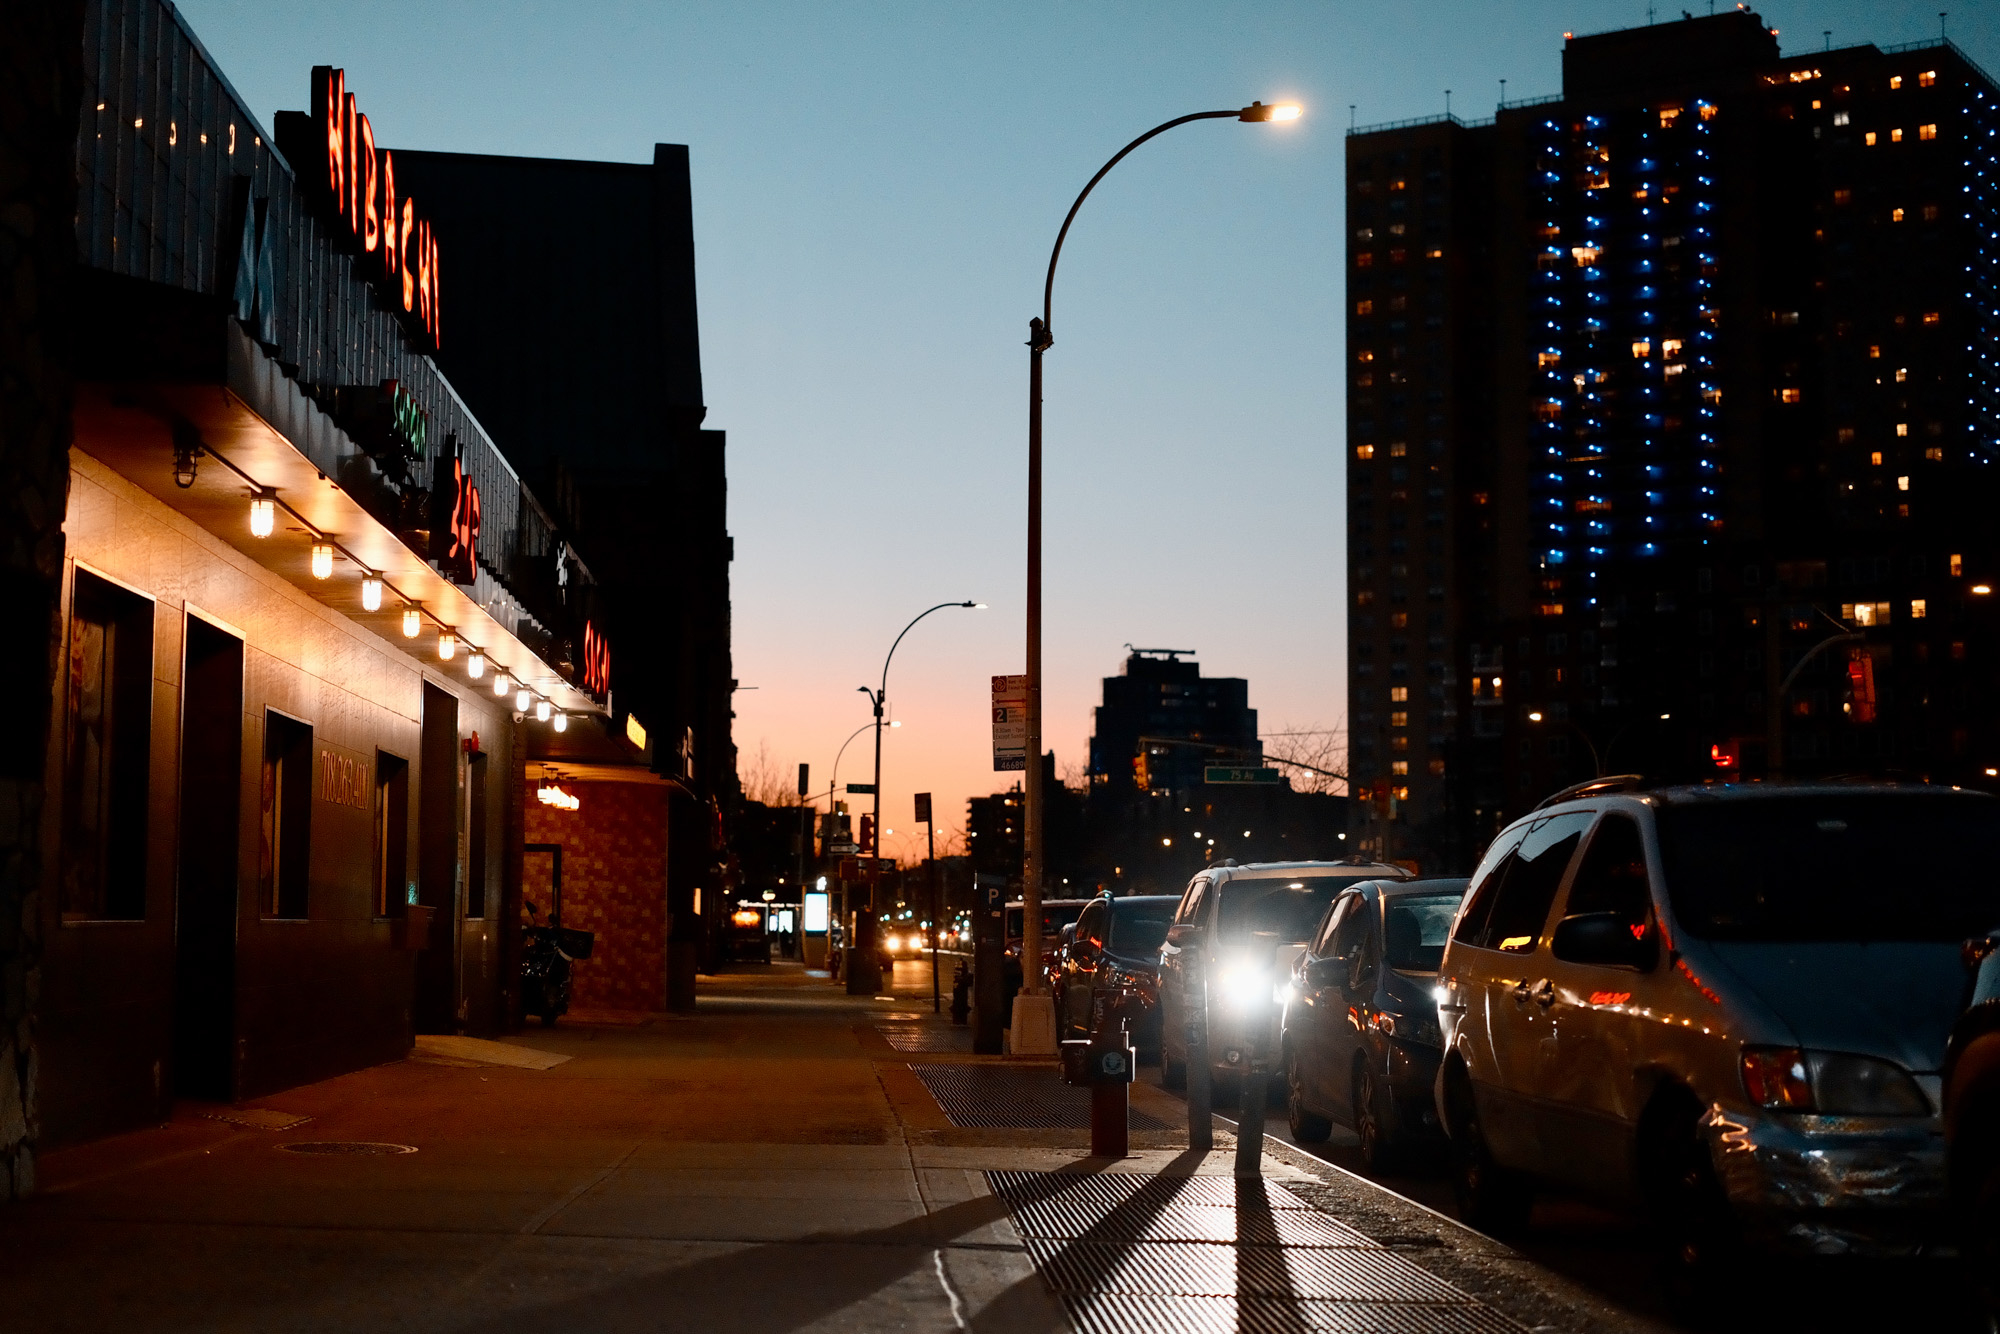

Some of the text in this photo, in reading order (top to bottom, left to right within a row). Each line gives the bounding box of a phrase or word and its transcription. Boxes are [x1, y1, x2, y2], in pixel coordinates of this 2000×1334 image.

[327, 68, 440, 350] HIBACHI
[584, 618, 610, 694] SUSHI
[997, 709, 1004, 722] 2
[988, 888, 1000, 904] P
